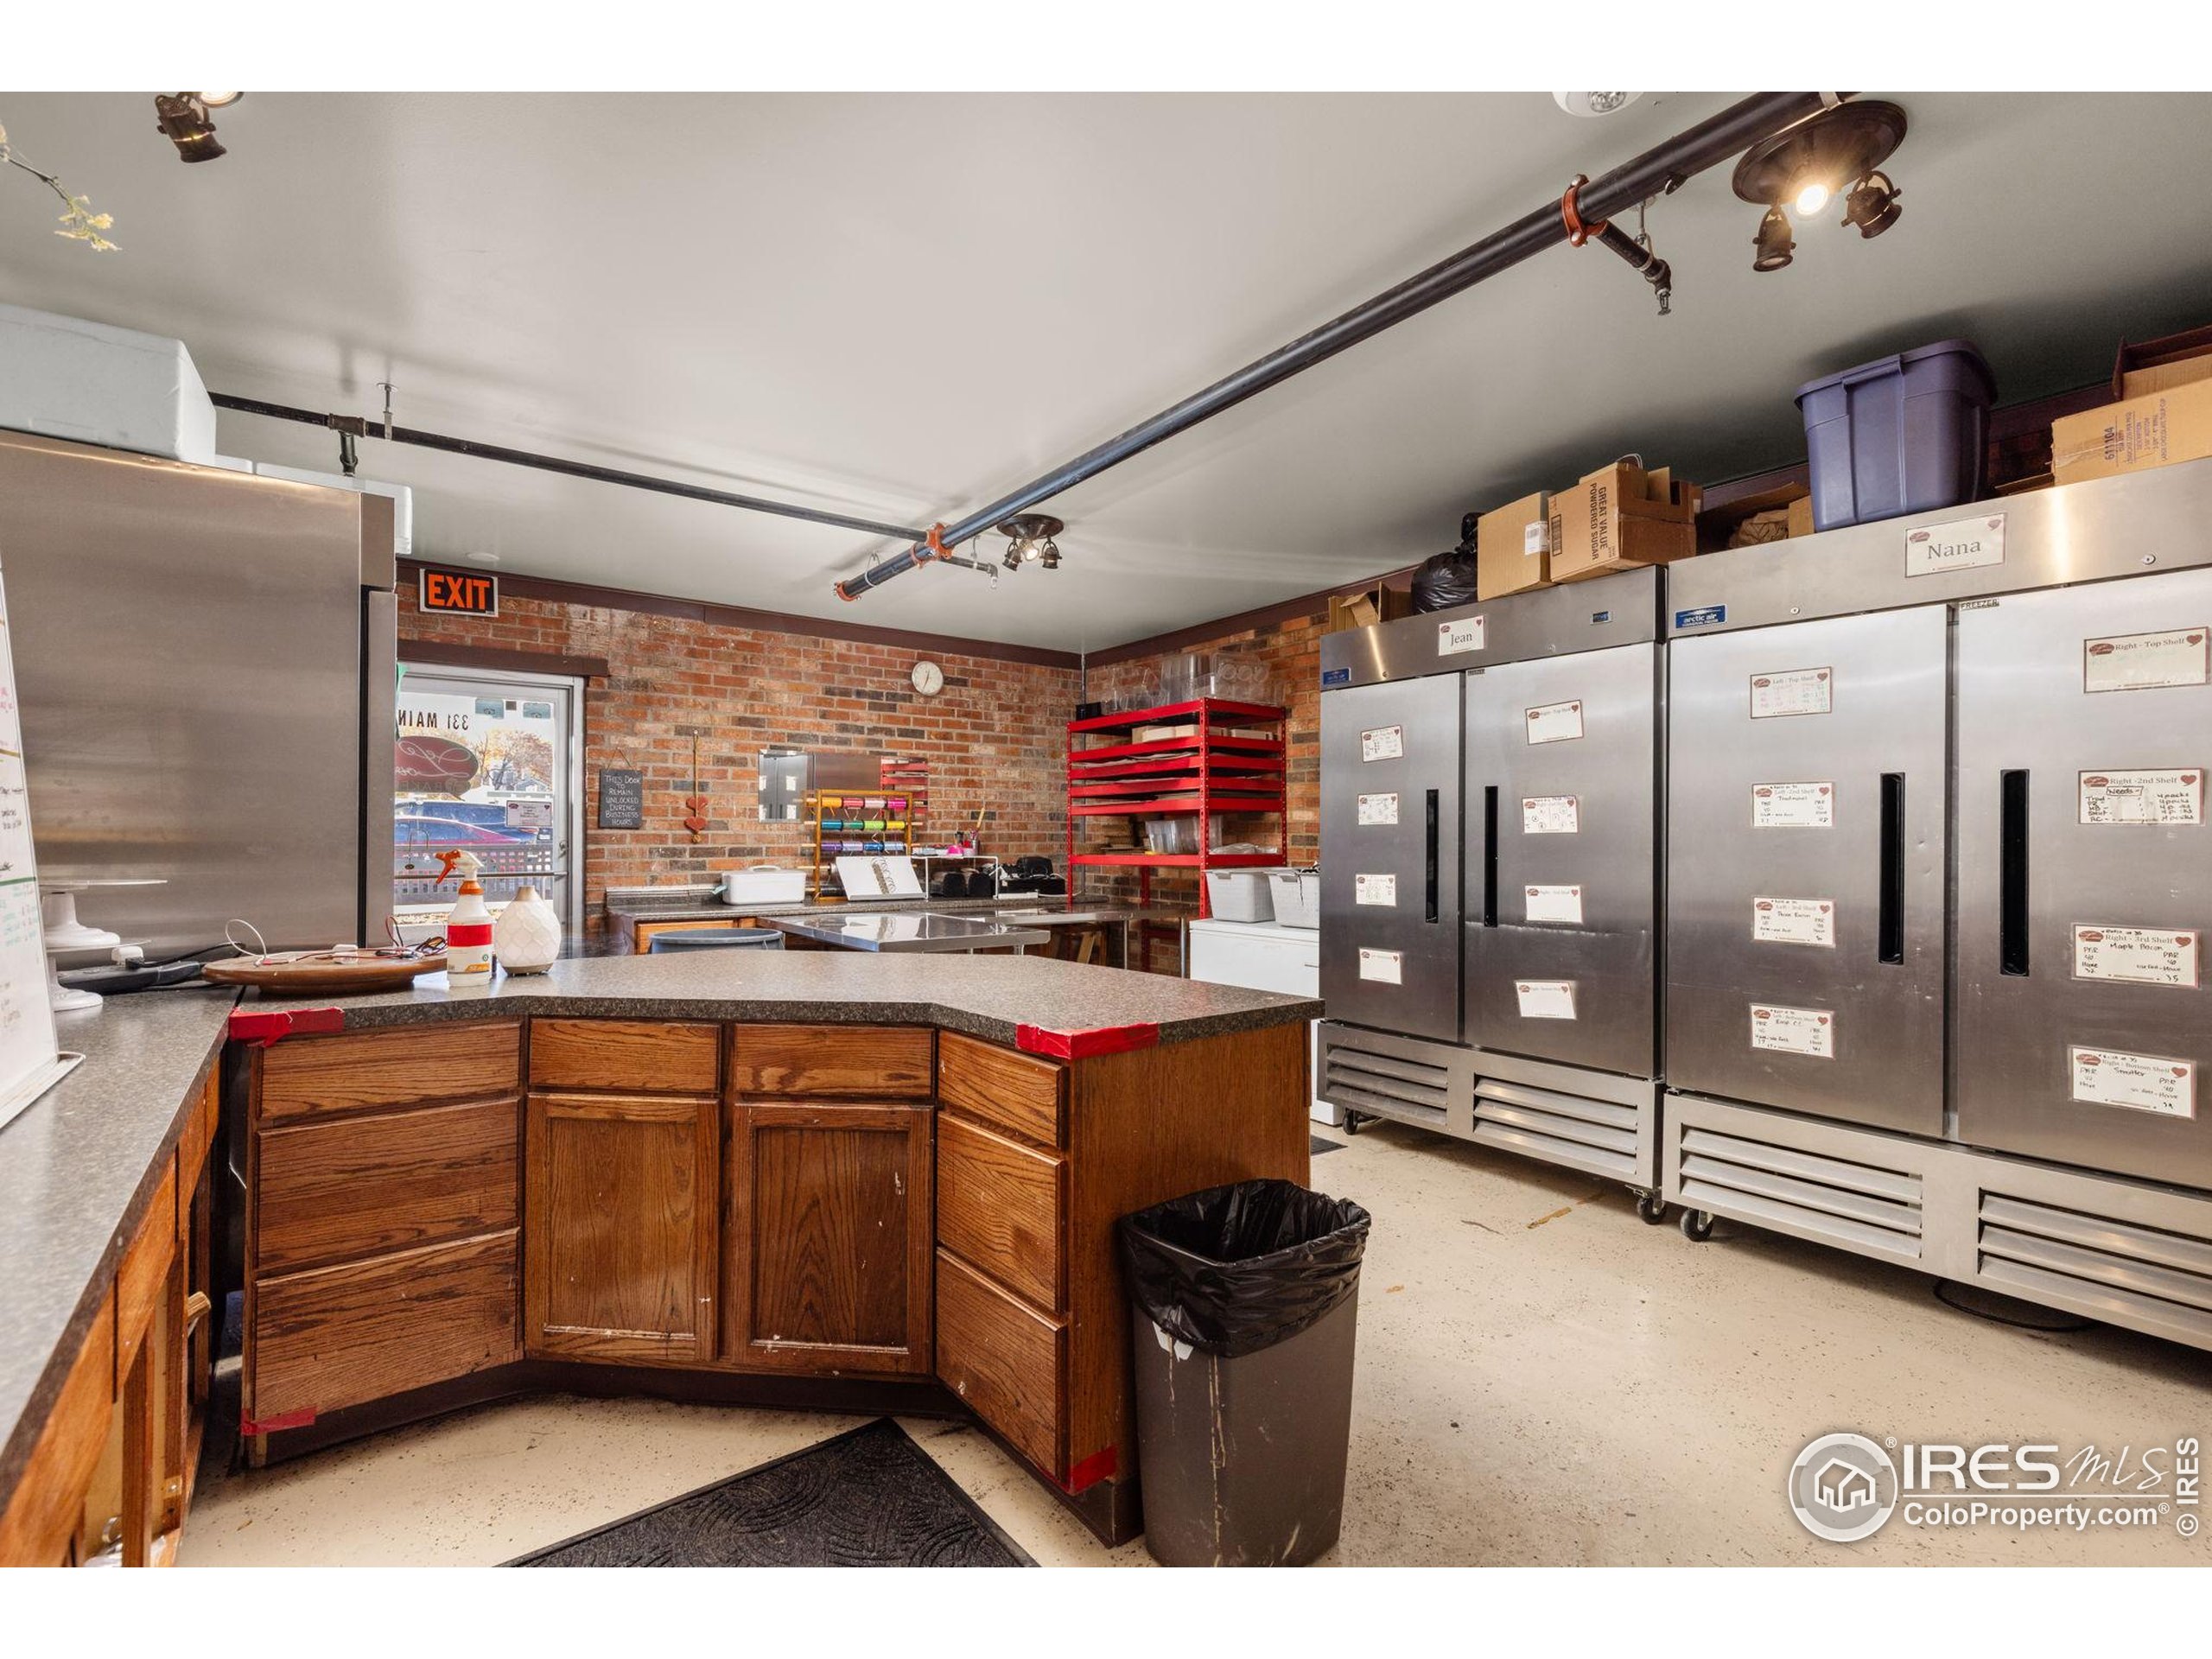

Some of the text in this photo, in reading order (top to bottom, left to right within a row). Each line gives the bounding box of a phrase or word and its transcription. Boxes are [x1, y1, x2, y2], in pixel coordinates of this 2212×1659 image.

[1590, 482, 1599, 561] POWDERED SUGAR
[1599, 486, 1608, 550] GREAT VALUE
[1928, 540, 1981, 560] Nana
[428, 573, 490, 610] EXIT
[1961, 598, 1999, 609] FREEZER
[1683, 614, 1706, 623] arctic
[1451, 632, 1473, 646] Jean
[2115, 642, 2137, 651] Right
[2145, 640, 2161, 649] Top
[2163, 638, 2185, 646] Shelf
[605, 775, 623, 785] THIS
[2152, 936, 2173, 944] Shelf
